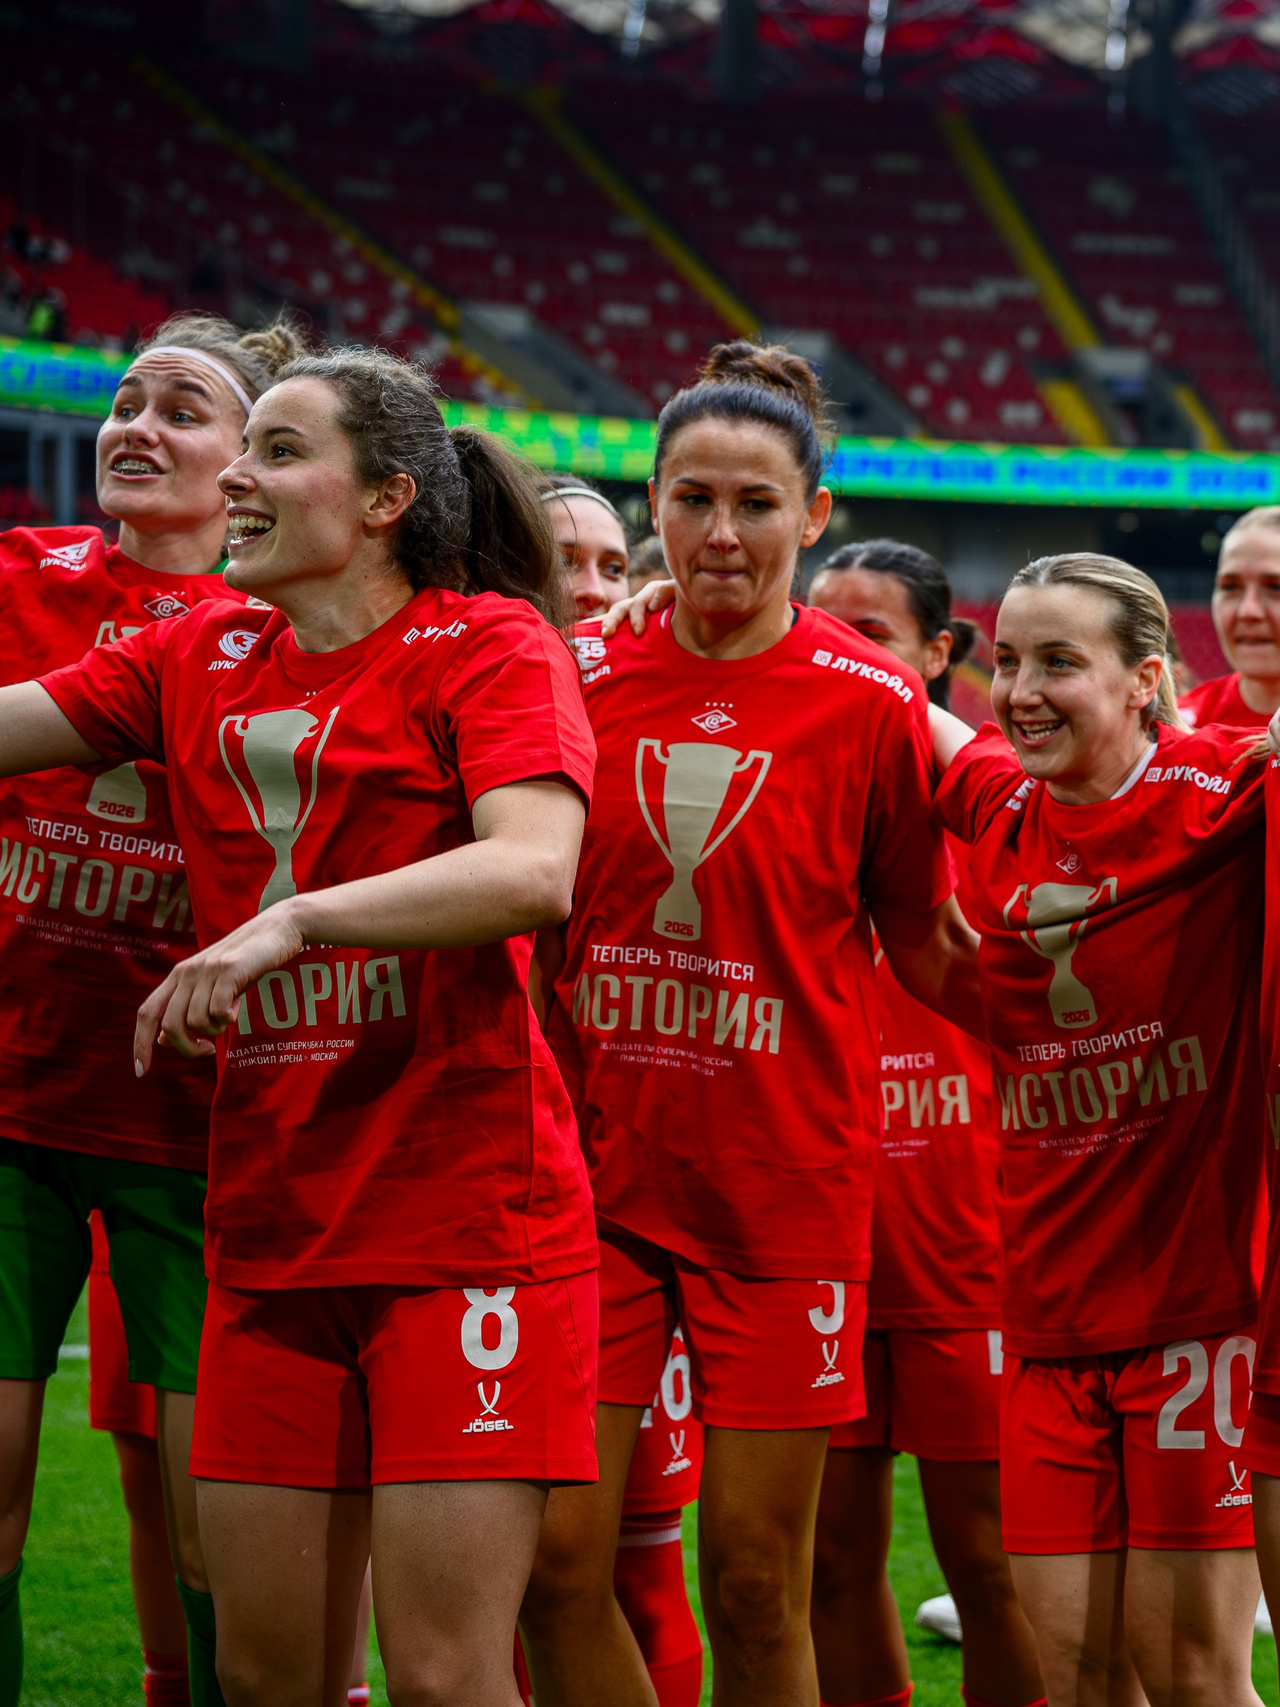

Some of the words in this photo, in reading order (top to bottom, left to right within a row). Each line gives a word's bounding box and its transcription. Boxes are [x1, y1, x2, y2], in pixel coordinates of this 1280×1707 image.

[831, 656, 914, 704] ЛУКОЙЛ
[1161, 765, 1232, 795] ЛУКОЙЛ
[98, 801, 136, 818] 2026
[25, 816, 90, 845] ТЕПЕРЬ
[0, 837, 196, 933] ИСТОРИ
[664, 920, 694, 937] 2026
[591, 944, 661, 966] ТЕПЕРЬ
[668, 950, 755, 982] ТВОРИТСЯ
[572, 971, 785, 1055] ИСТОРИЯ
[1061, 1009, 1091, 1025] 2026
[277, 1040, 324, 1051] СУПЕРКУБКА
[326, 1039, 355, 1049] РОССИИ
[311, 1052, 338, 1061] МОСКВА
[1017, 1042, 1066, 1062] ТЕПЕРЬ
[1072, 1021, 1165, 1057] ТВОРИТСЯ
[996, 1035, 1208, 1131] ИСТОРИЯ
[461, 1286, 519, 1371] 8
[1157, 1335, 1257, 1449] 20
[462, 1418, 515, 1433] JÖGEL
